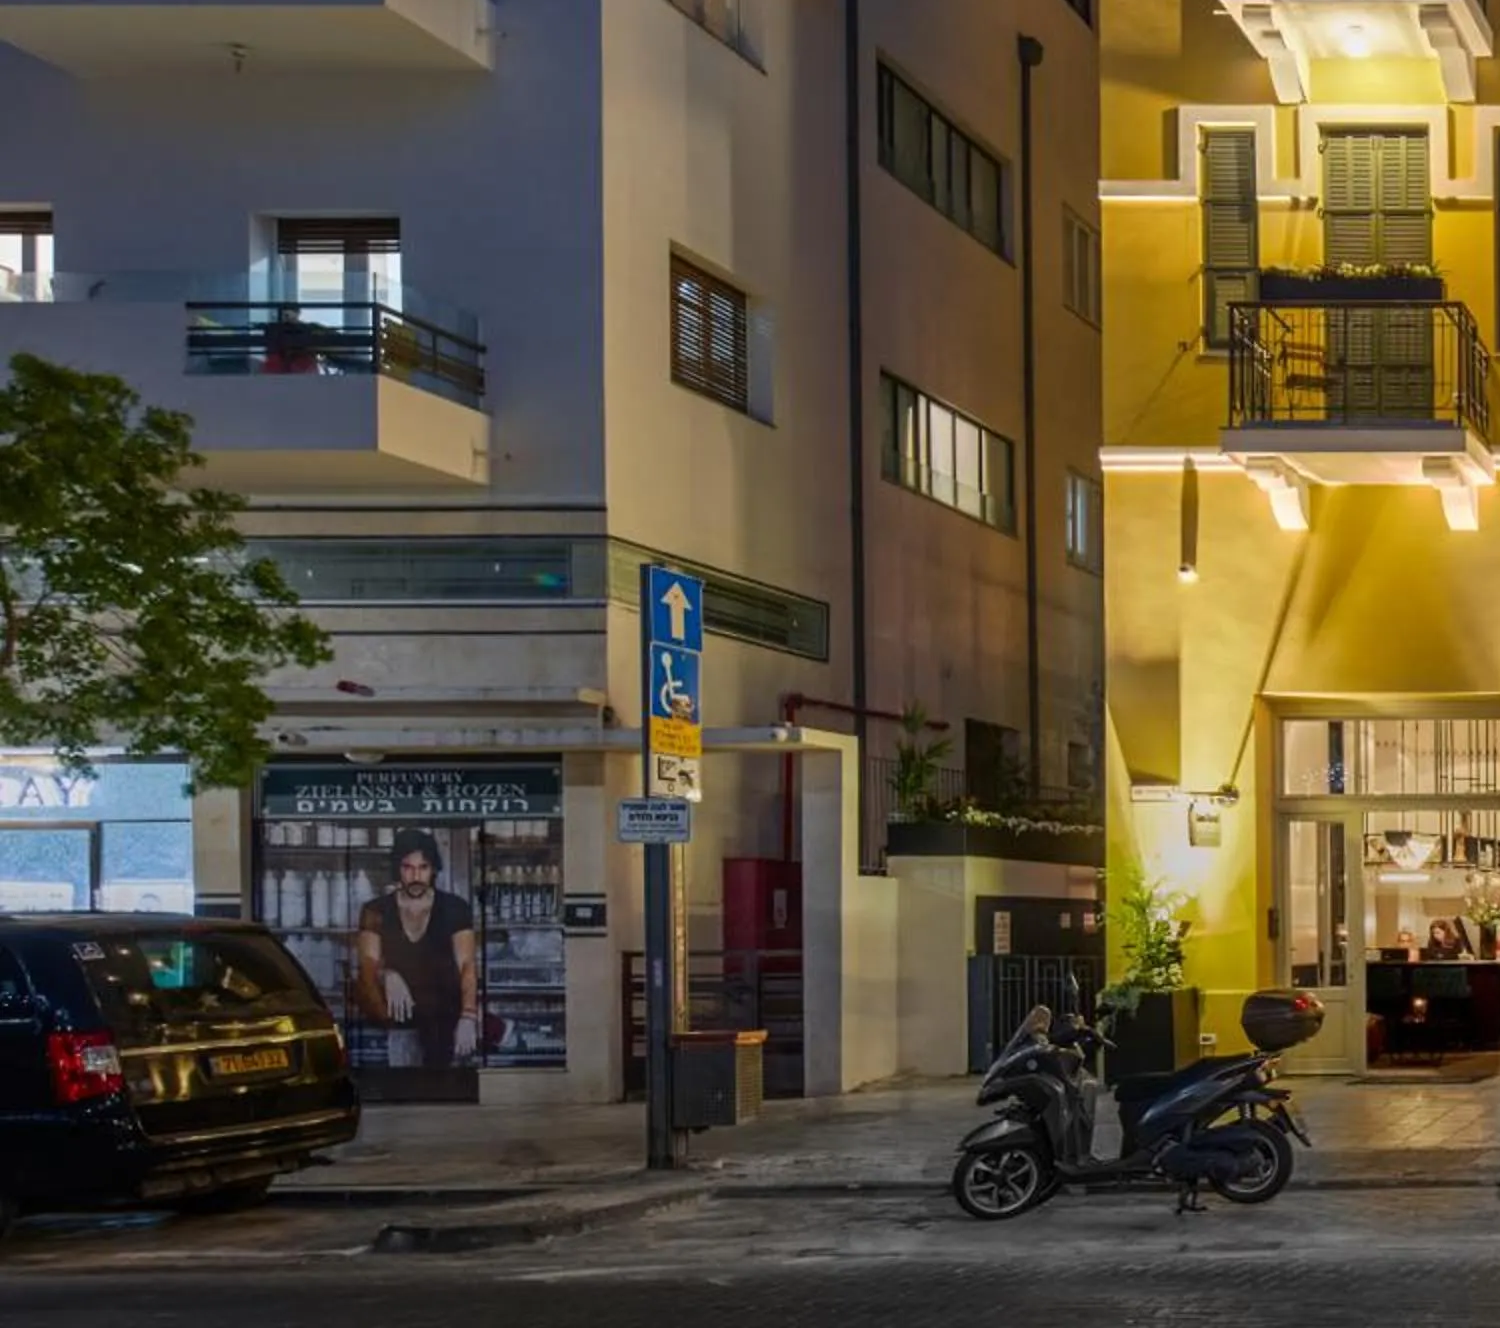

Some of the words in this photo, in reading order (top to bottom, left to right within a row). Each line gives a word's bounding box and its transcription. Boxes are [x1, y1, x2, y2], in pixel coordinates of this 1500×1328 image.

[357, 772, 464, 785] PERFUMERY
[0, 775, 83, 805] AY
[295, 785, 414, 799] ZIELINSKI
[421, 785, 439, 798] &
[445, 785, 527, 799] ROZEN
[296, 799, 396, 813] בשמים
[422, 798, 530, 814] רוקחות
